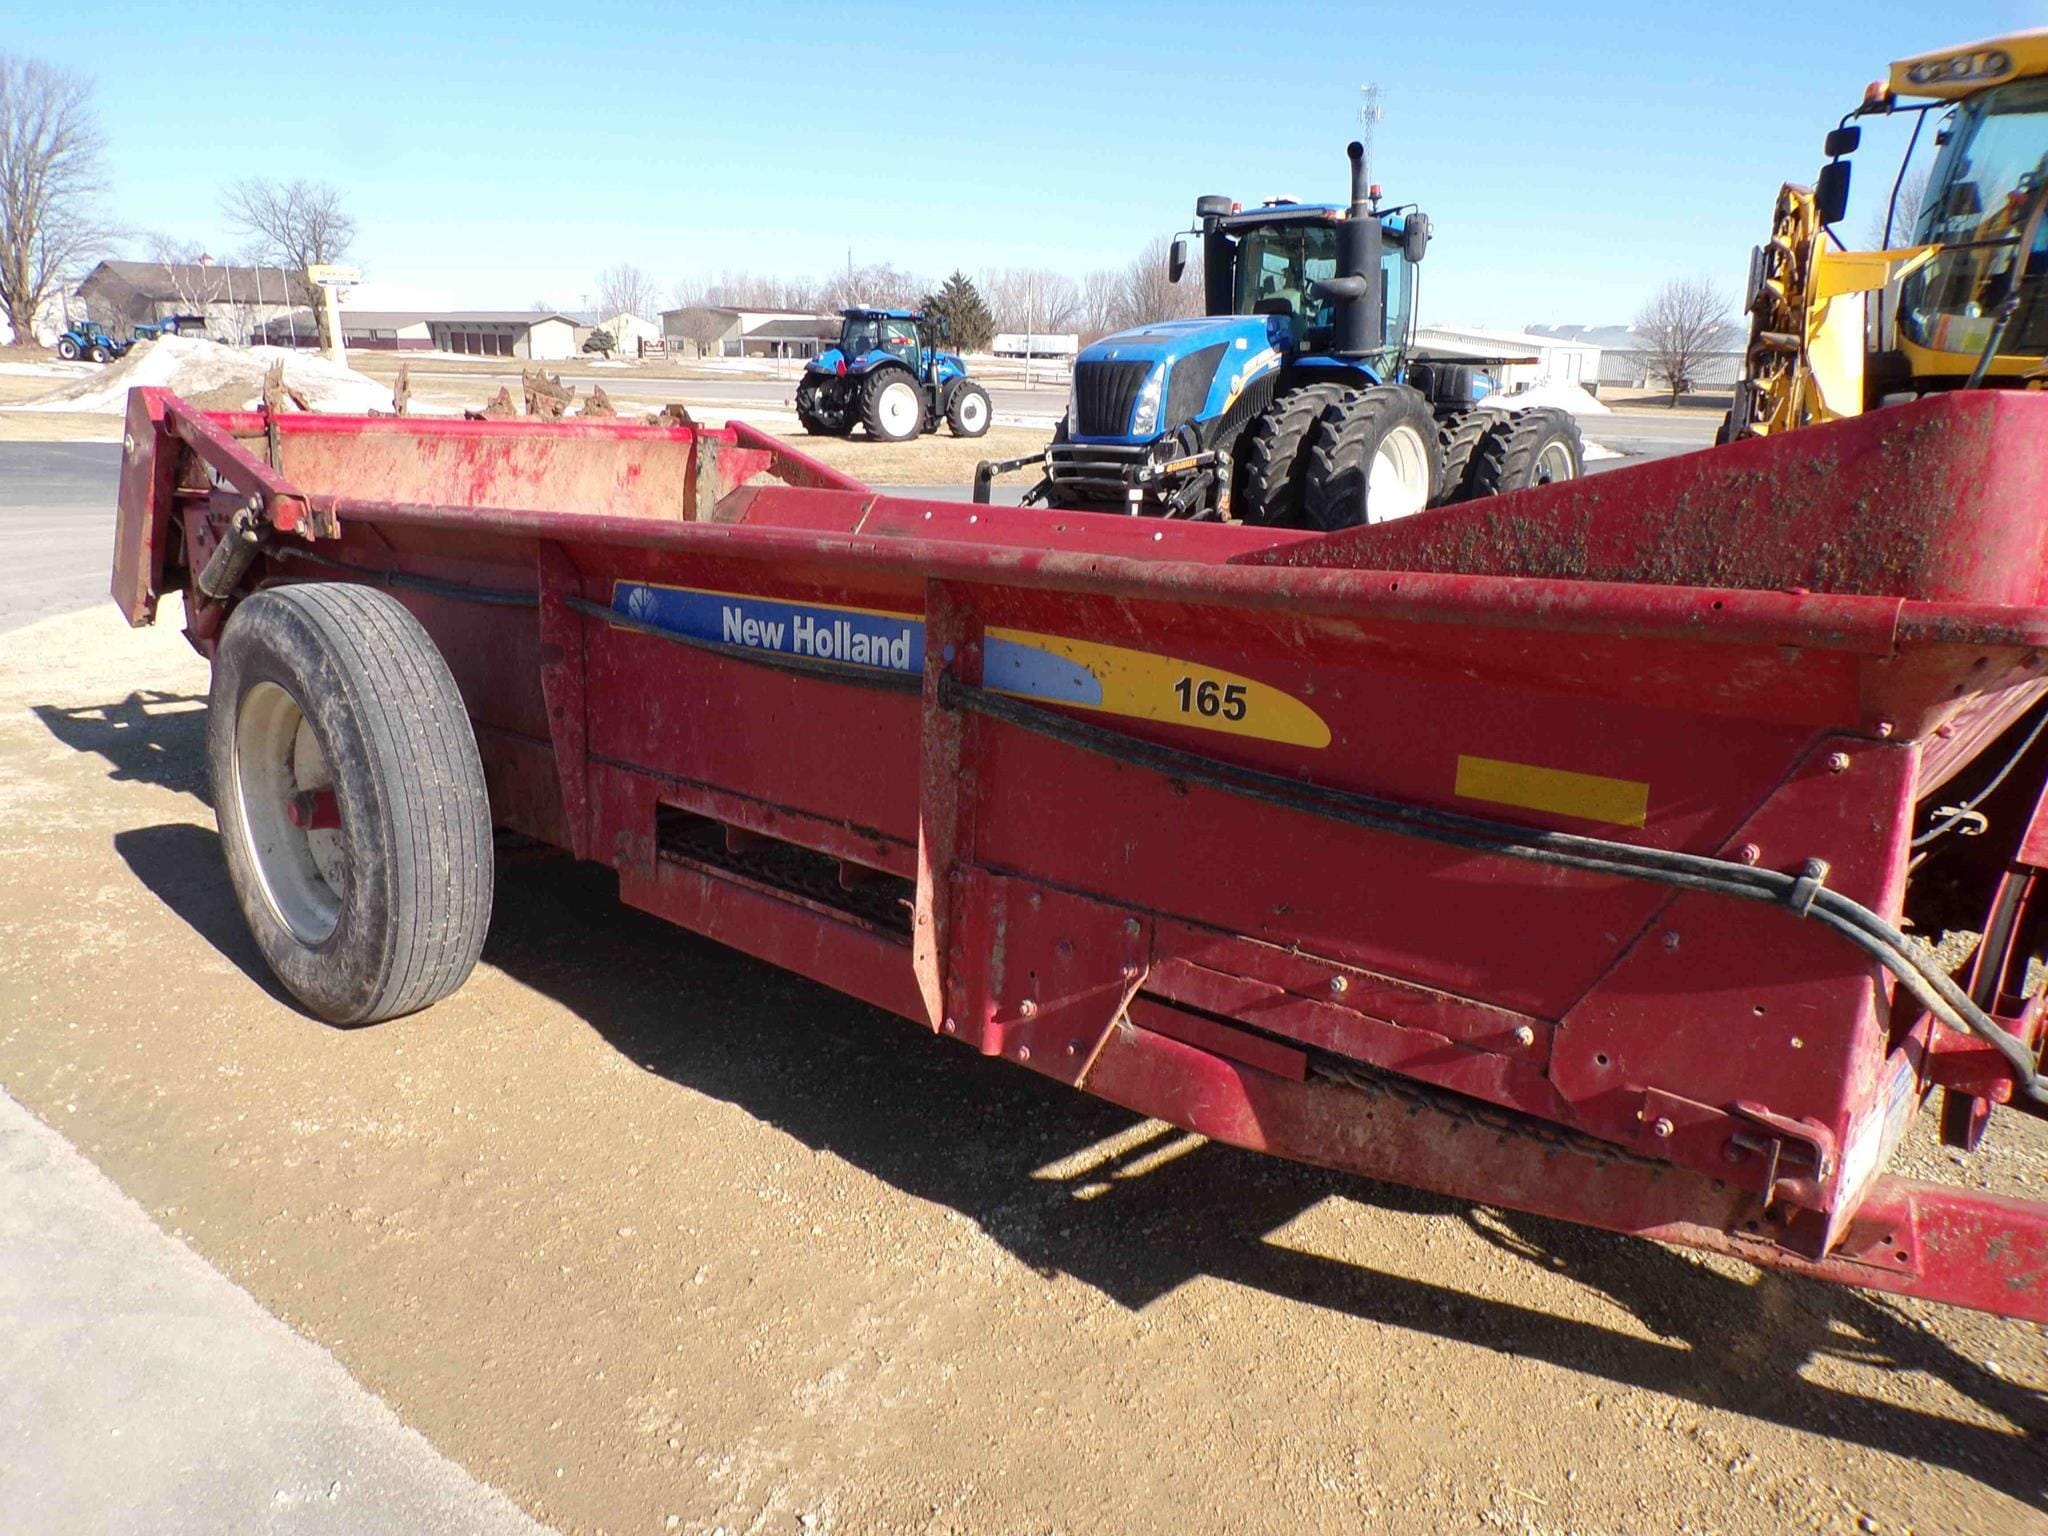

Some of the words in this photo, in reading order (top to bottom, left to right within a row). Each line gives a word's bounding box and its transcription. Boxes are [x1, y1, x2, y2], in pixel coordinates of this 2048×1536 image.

[722, 605, 785, 650] New
[793, 615, 910, 670] Holland
[1174, 677, 1247, 721] 165
